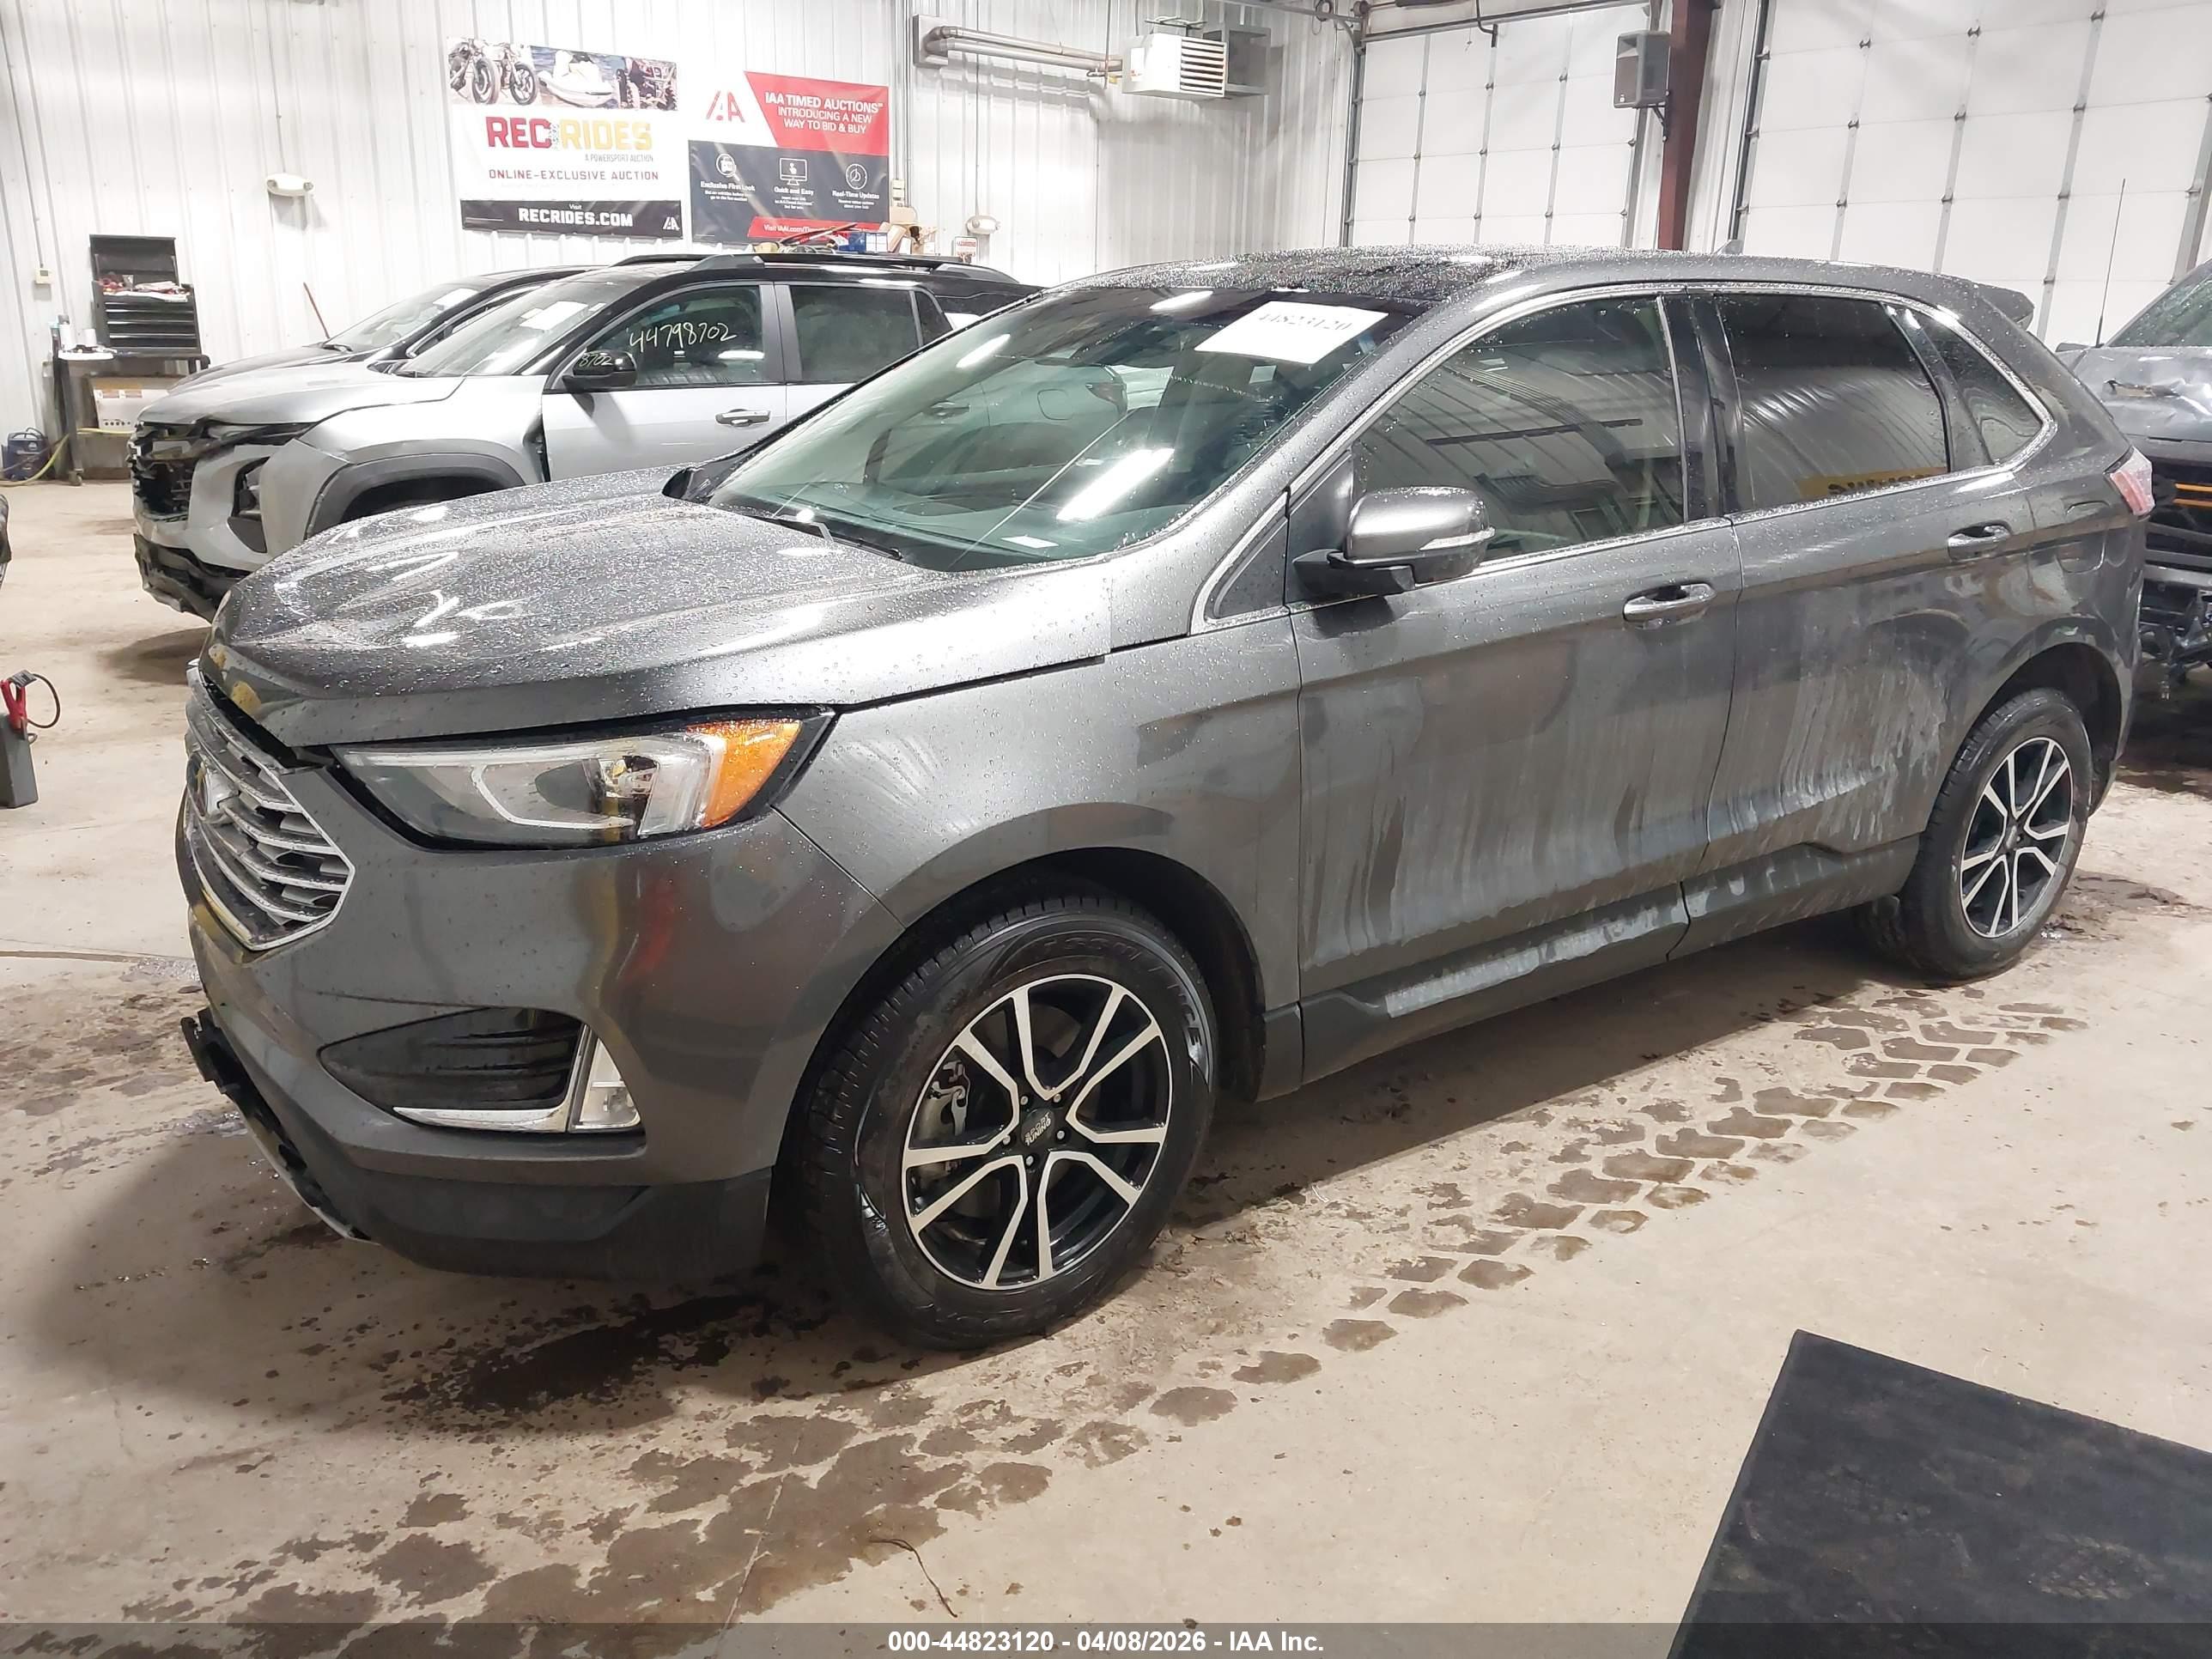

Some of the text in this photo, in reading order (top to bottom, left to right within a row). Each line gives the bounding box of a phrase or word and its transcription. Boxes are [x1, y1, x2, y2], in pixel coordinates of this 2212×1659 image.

[765, 92, 784, 105] IAA
[785, 94, 822, 108] TIMED
[778, 106, 872, 124] INTRODUCING A NEW
[485, 117, 652, 150] REC RIDES
[783, 118, 866, 134] WAY TO BID & BUY
[489, 169, 659, 180] ONLINE-EXCLUSIVE AUCTION
[801, 188, 814, 197] Easy
[832, 190, 880, 200] Real-Time Updates
[518, 208, 634, 228] RECRIDES.COM
[629, 322, 738, 353] 44798702
[579, 352, 613, 368] 8702
